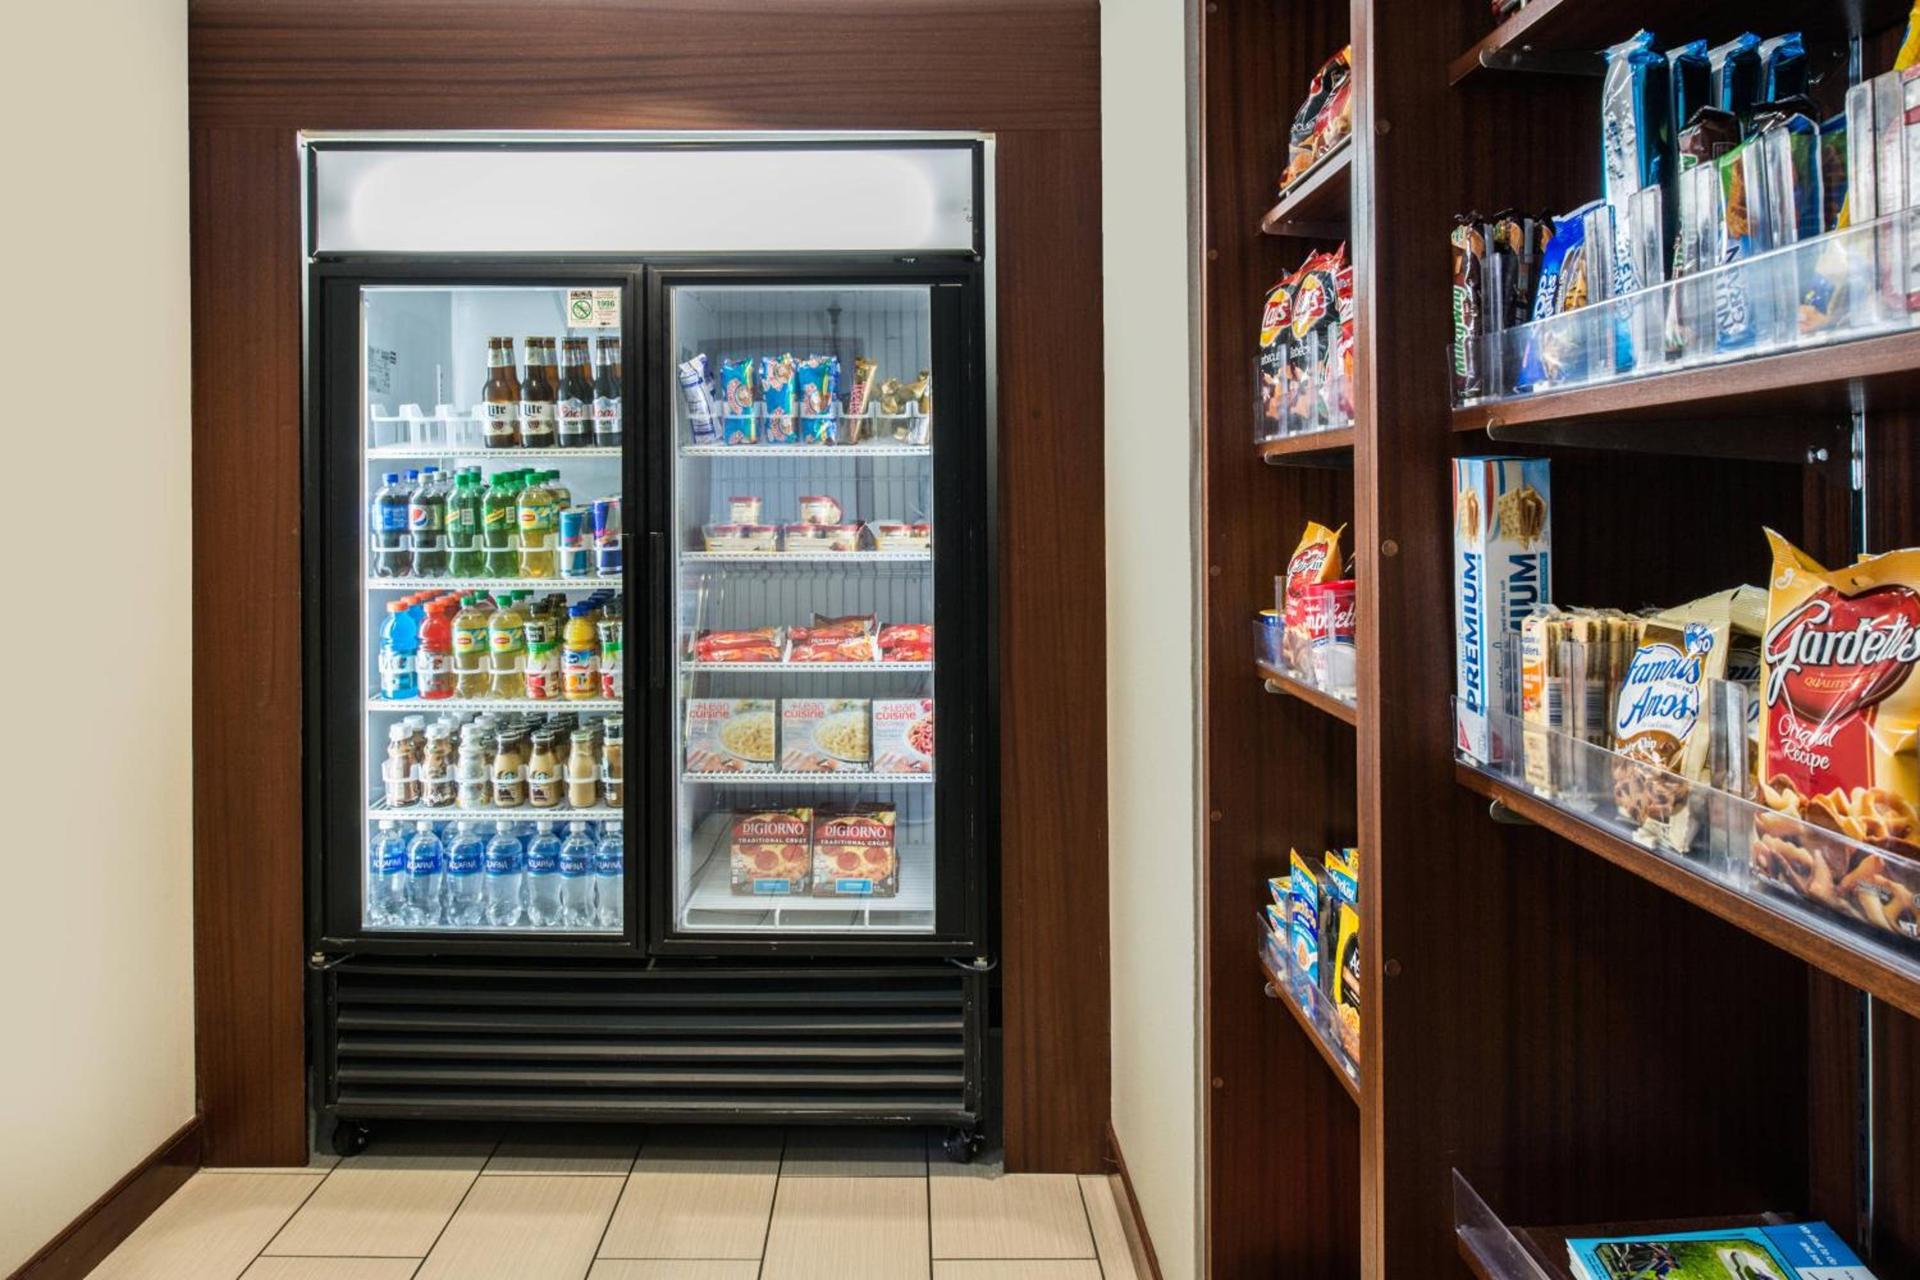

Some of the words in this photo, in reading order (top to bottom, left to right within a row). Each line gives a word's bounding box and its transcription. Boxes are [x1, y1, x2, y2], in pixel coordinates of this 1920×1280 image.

[1463, 551, 1478, 714] PREMIUM
[1620, 647, 1702, 692] Famous
[1620, 686, 1690, 729] Amos
[1781, 738, 1831, 776] Recipe
